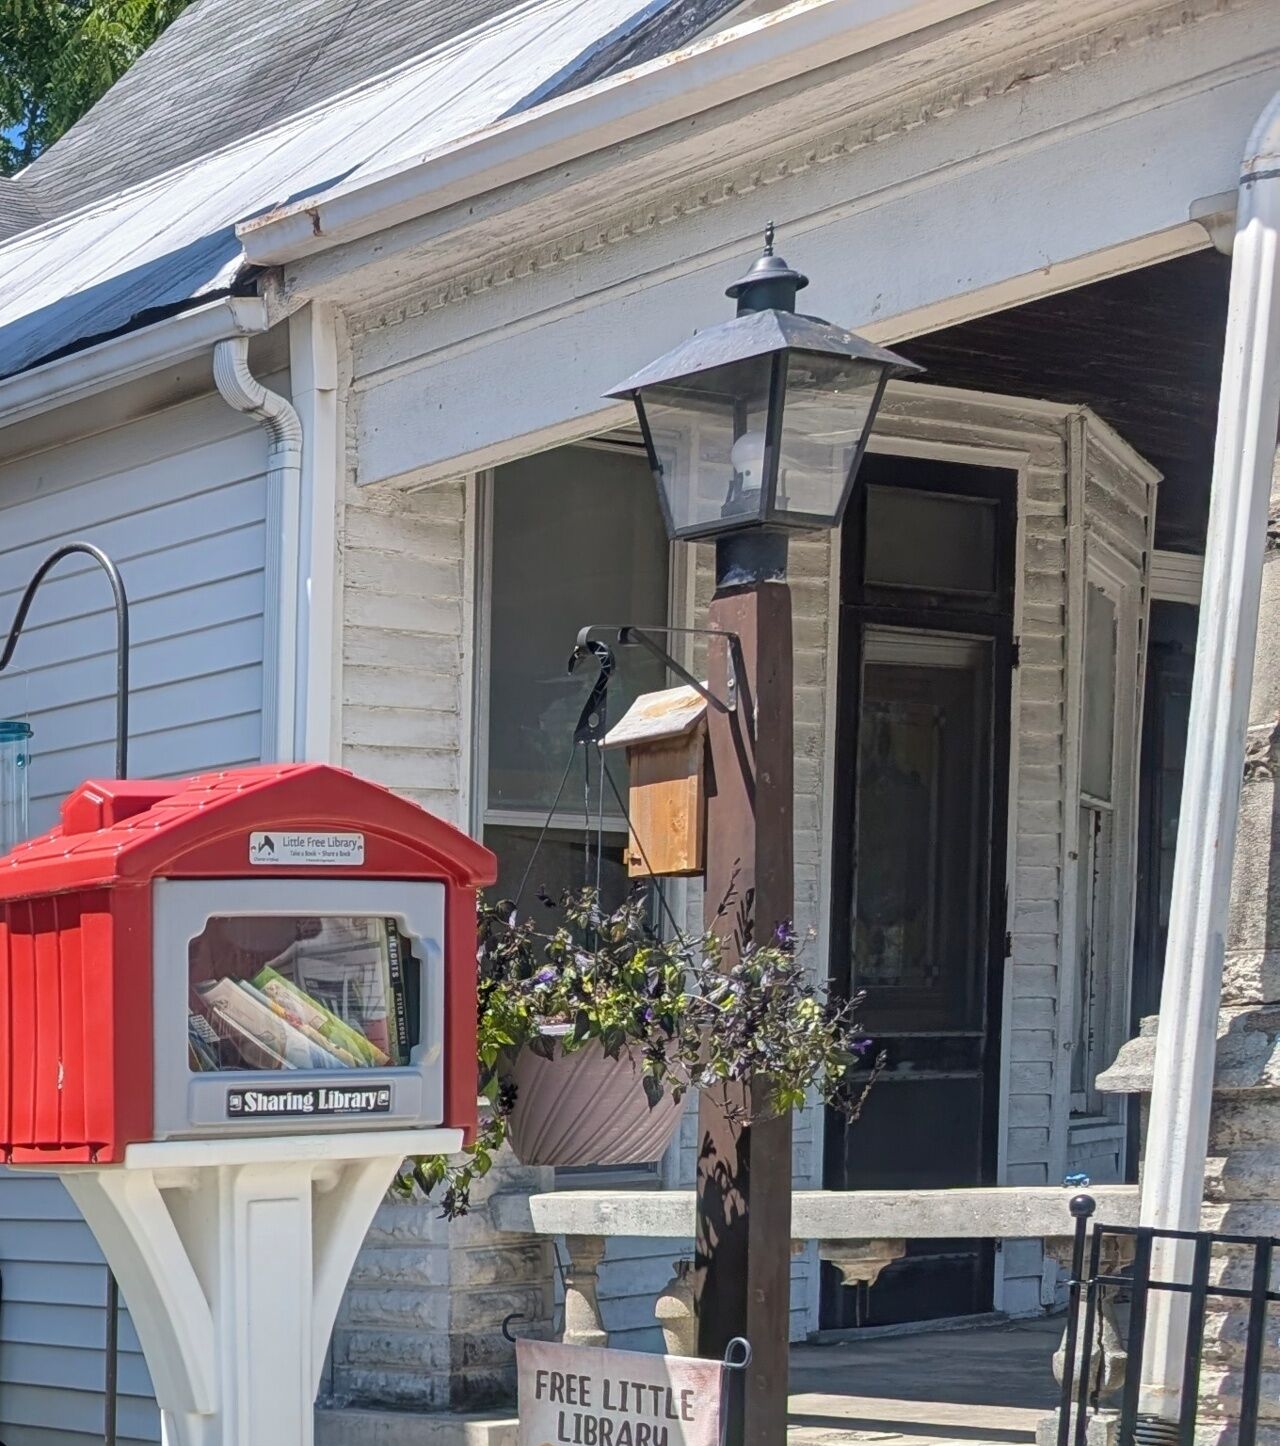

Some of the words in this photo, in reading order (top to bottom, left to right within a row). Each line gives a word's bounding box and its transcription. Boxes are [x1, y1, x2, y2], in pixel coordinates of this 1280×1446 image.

[282, 836, 304, 848] Little
[307, 836, 326, 848] Free
[327, 836, 357, 851] Library
[388, 935, 400, 978] HEIGHTS
[244, 1091, 314, 1112] Sharing
[318, 1089, 377, 1110] Library
[535, 1369, 591, 1407] FREE
[603, 1379, 695, 1421] LITTLE
